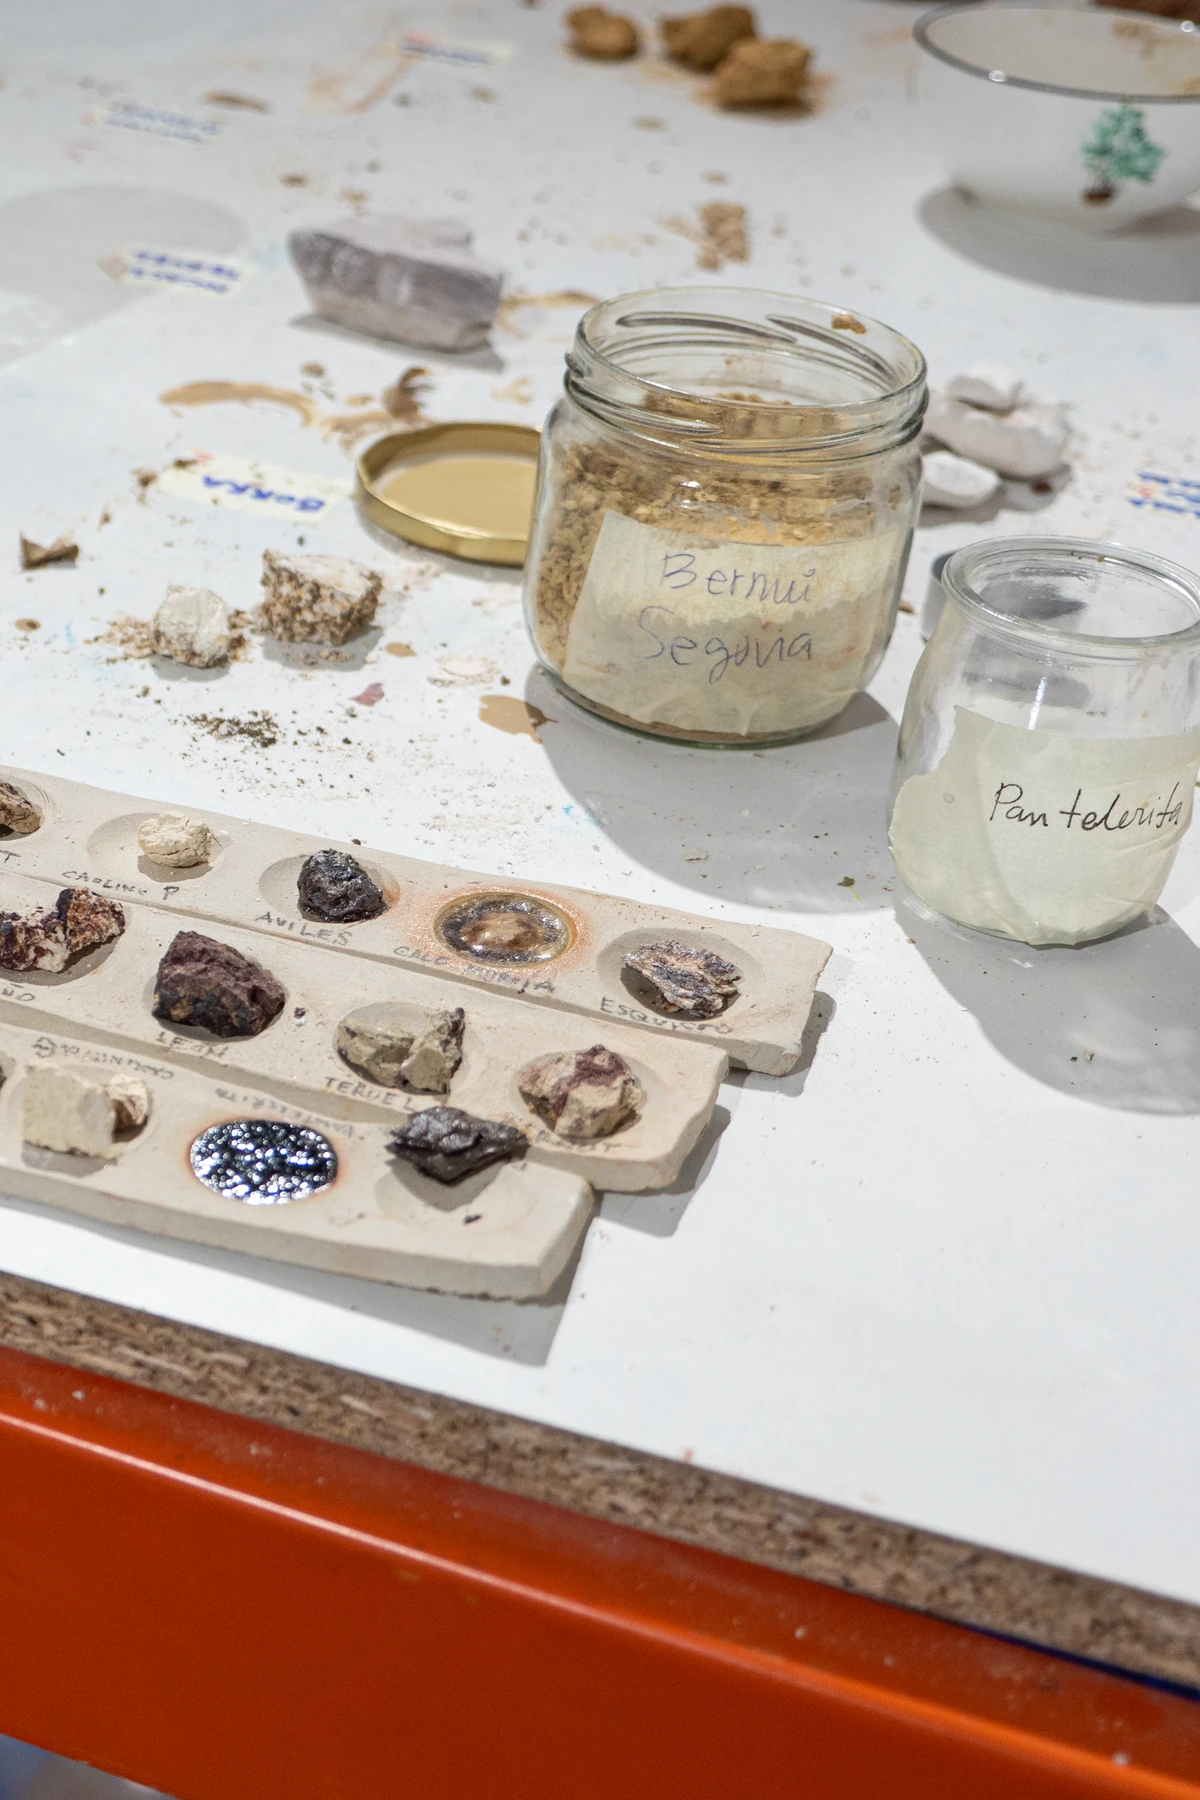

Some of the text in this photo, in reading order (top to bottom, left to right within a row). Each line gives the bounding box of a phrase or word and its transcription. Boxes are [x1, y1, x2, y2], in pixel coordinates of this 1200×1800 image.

[638, 604, 813, 685] Segovia
[254, 910, 353, 946] AVILES
[323, 1075, 417, 1114] TERUEL
